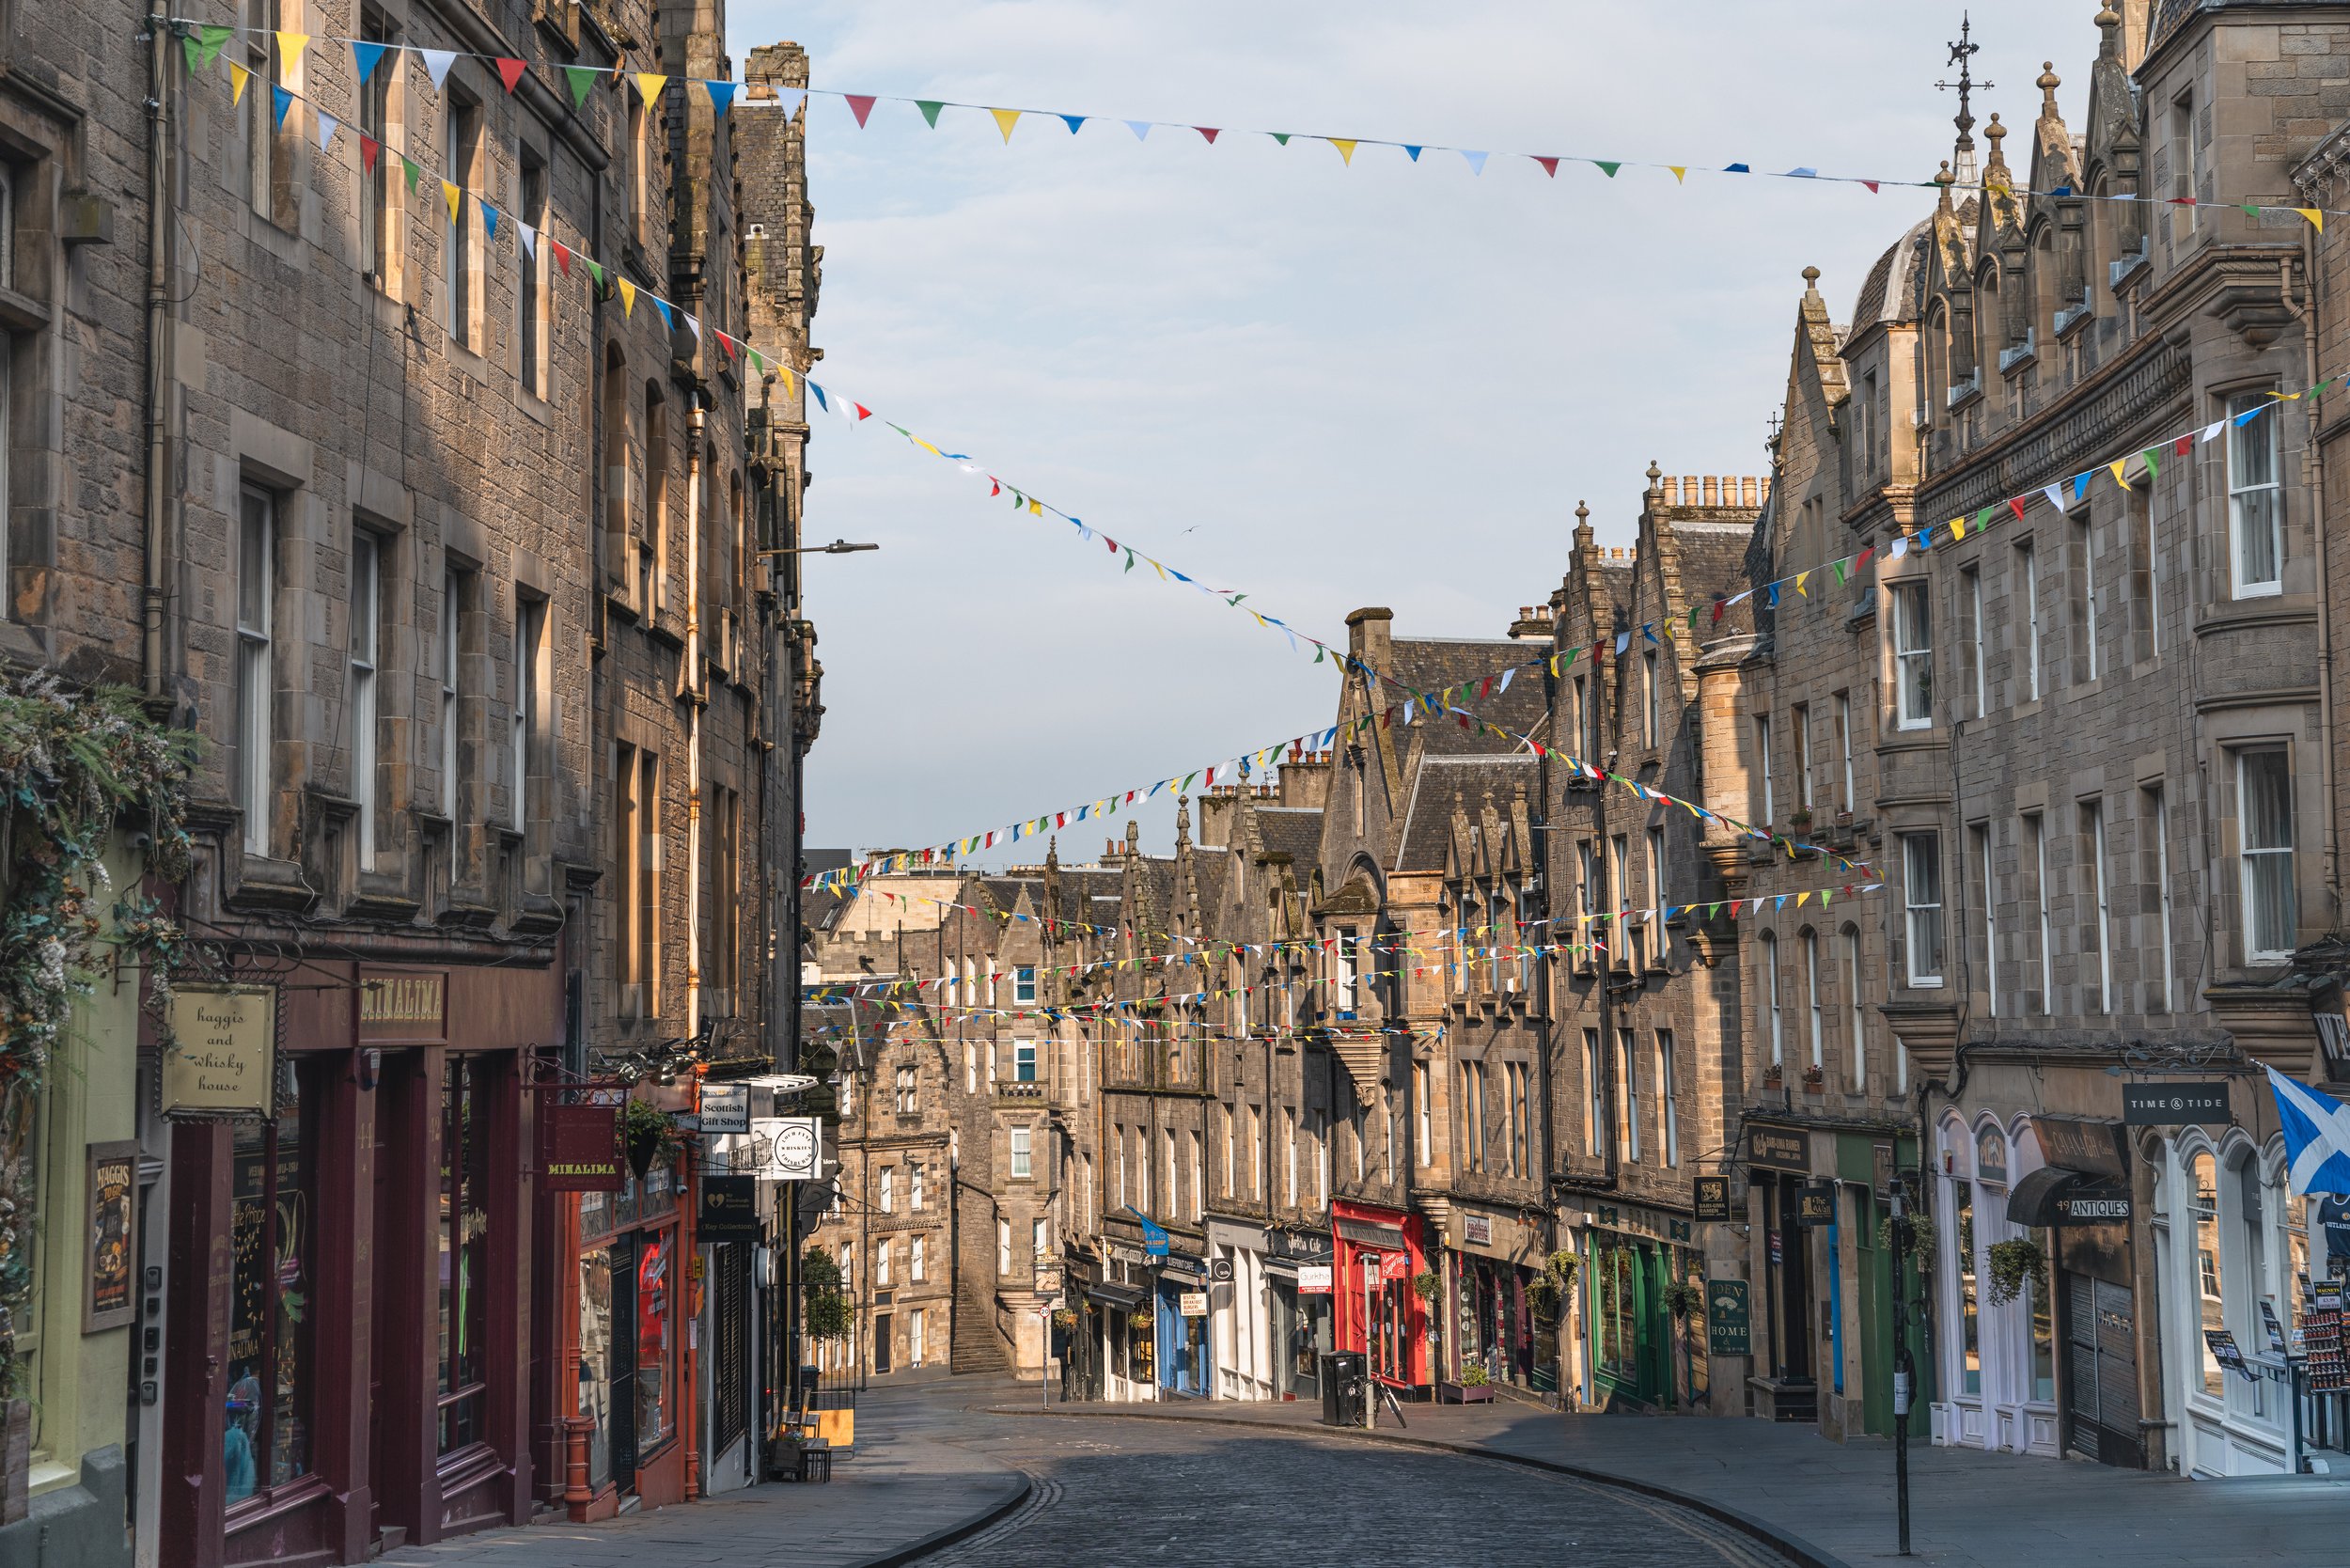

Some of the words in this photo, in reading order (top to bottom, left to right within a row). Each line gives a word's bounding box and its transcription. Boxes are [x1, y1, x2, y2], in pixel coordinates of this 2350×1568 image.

[360, 978, 442, 1023] MINALIMA
[196, 1006, 245, 1030] haggis
[207, 1033, 234, 1046] and
[194, 1053, 244, 1076] whisky
[197, 1075, 241, 1091] house
[704, 1104, 744, 1113] Scottish
[2131, 1099, 2166, 1108] TIME
[2187, 1099, 2222, 1107] TIDE
[701, 1117, 719, 1126] Gift
[720, 1117, 746, 1127] Shop
[358, 1122, 372, 1149] 44
[781, 1131, 796, 1143] LOCH
[797, 1131, 811, 1142] FYNE
[1785, 1138, 1801, 1152] RAMEN
[2052, 1131, 2101, 1159] CAVANAGH
[781, 1153, 812, 1166] EDINBURGH
[548, 1164, 617, 1175] MINALIMA
[97, 1165, 130, 1191] HAGGIS
[104, 1186, 112, 1200] TO
[1812, 1196, 1826, 1205] The
[2057, 1200, 2070, 1212] 49
[2072, 1200, 2129, 1216] ANTIQUES
[1466, 1219, 1488, 1241] cookie
[1628, 1208, 1661, 1238] EDEN
[1167, 1256, 1184, 1269] BLUEPRINT
[1299, 1271, 1330, 1281] Gurkha
[1711, 1325, 1747, 1337] HOME
